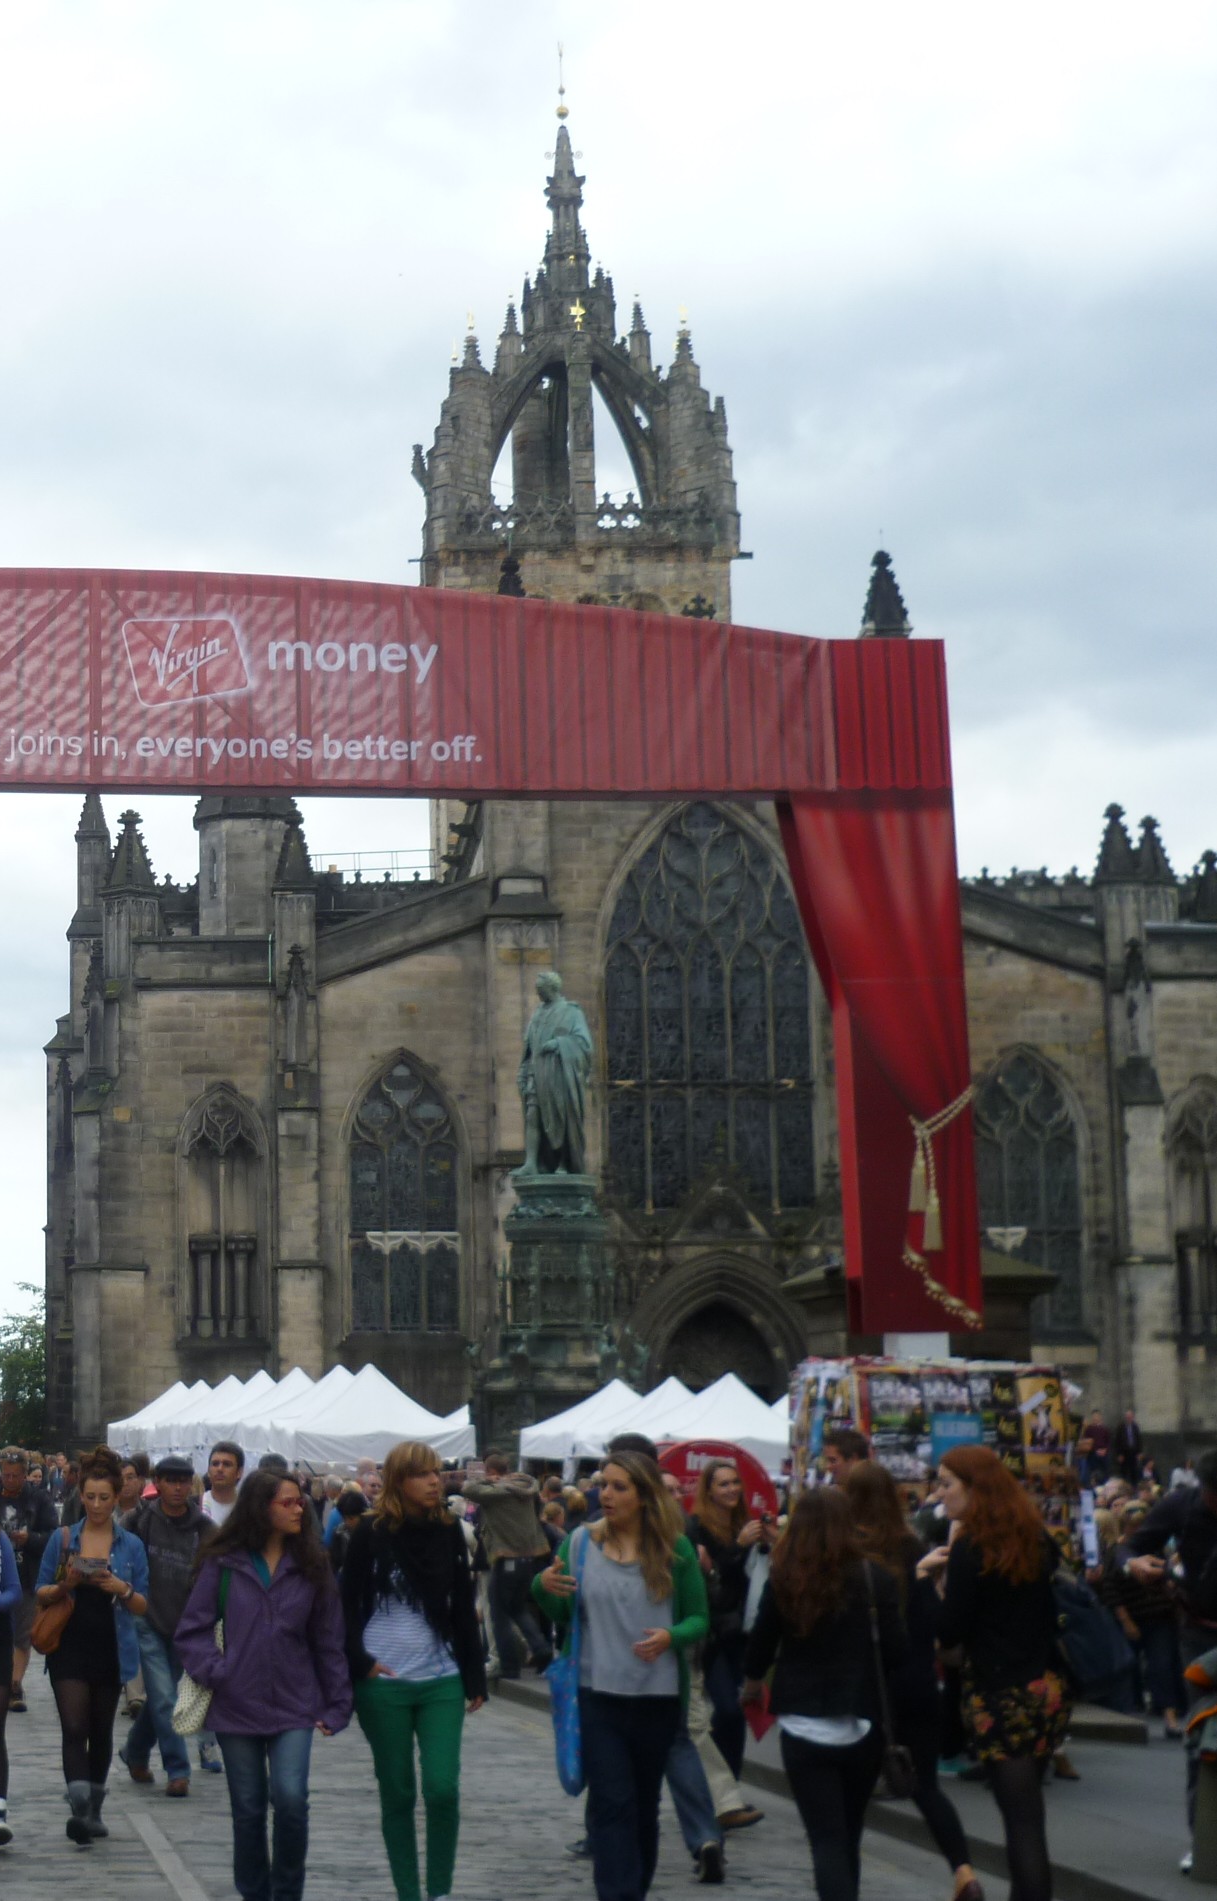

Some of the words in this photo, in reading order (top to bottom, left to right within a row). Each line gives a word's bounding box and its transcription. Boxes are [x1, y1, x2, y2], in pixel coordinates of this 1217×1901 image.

[148, 623, 229, 694] Virgin
[268, 640, 438, 684] money
[5, 729, 83, 762] joins
[93, 731, 128, 760] in,
[136, 733, 313, 765] everyone's
[323, 733, 422, 762] better
[430, 735, 483, 762] off.
